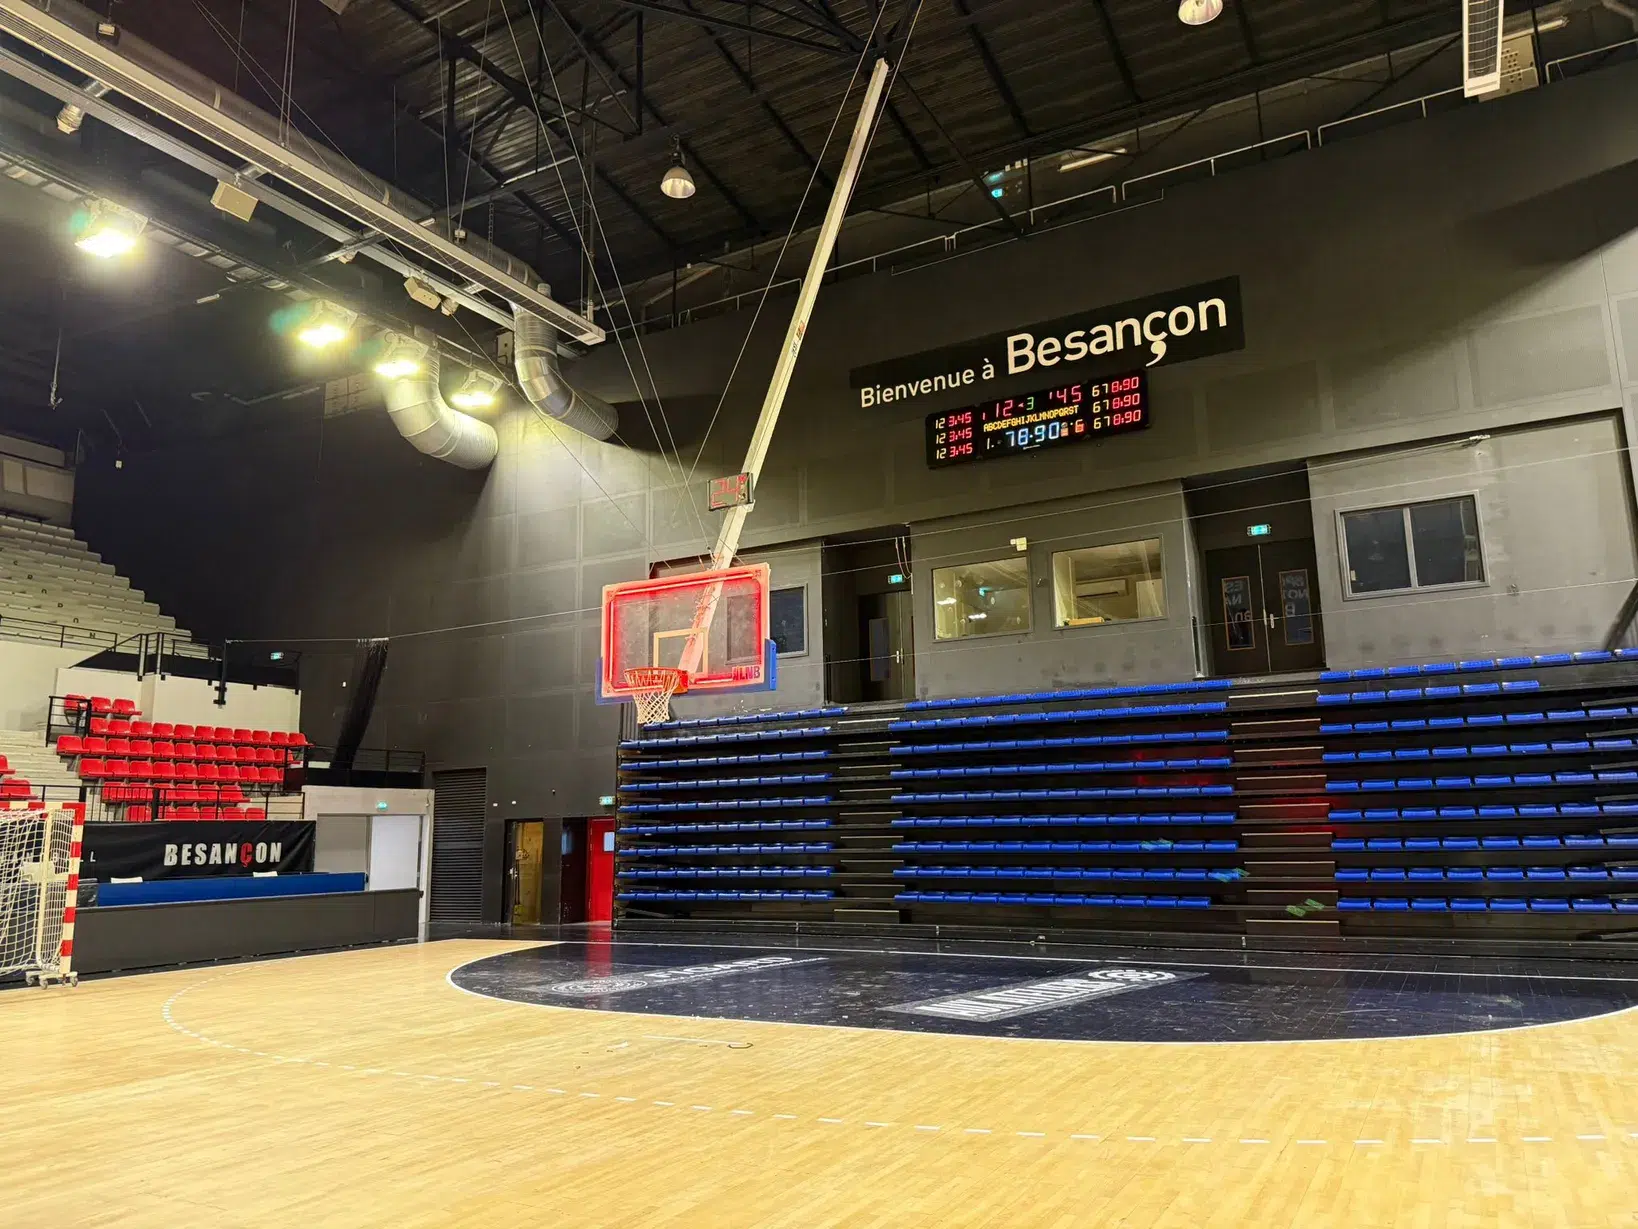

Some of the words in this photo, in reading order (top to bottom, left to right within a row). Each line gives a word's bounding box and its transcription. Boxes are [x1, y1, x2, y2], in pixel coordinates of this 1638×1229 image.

[861, 367, 975, 408] Bienvenue
[982, 358, 995, 380] à
[1006, 297, 1227, 375] Besançon
[164, 842, 282, 867] BESANÇON
